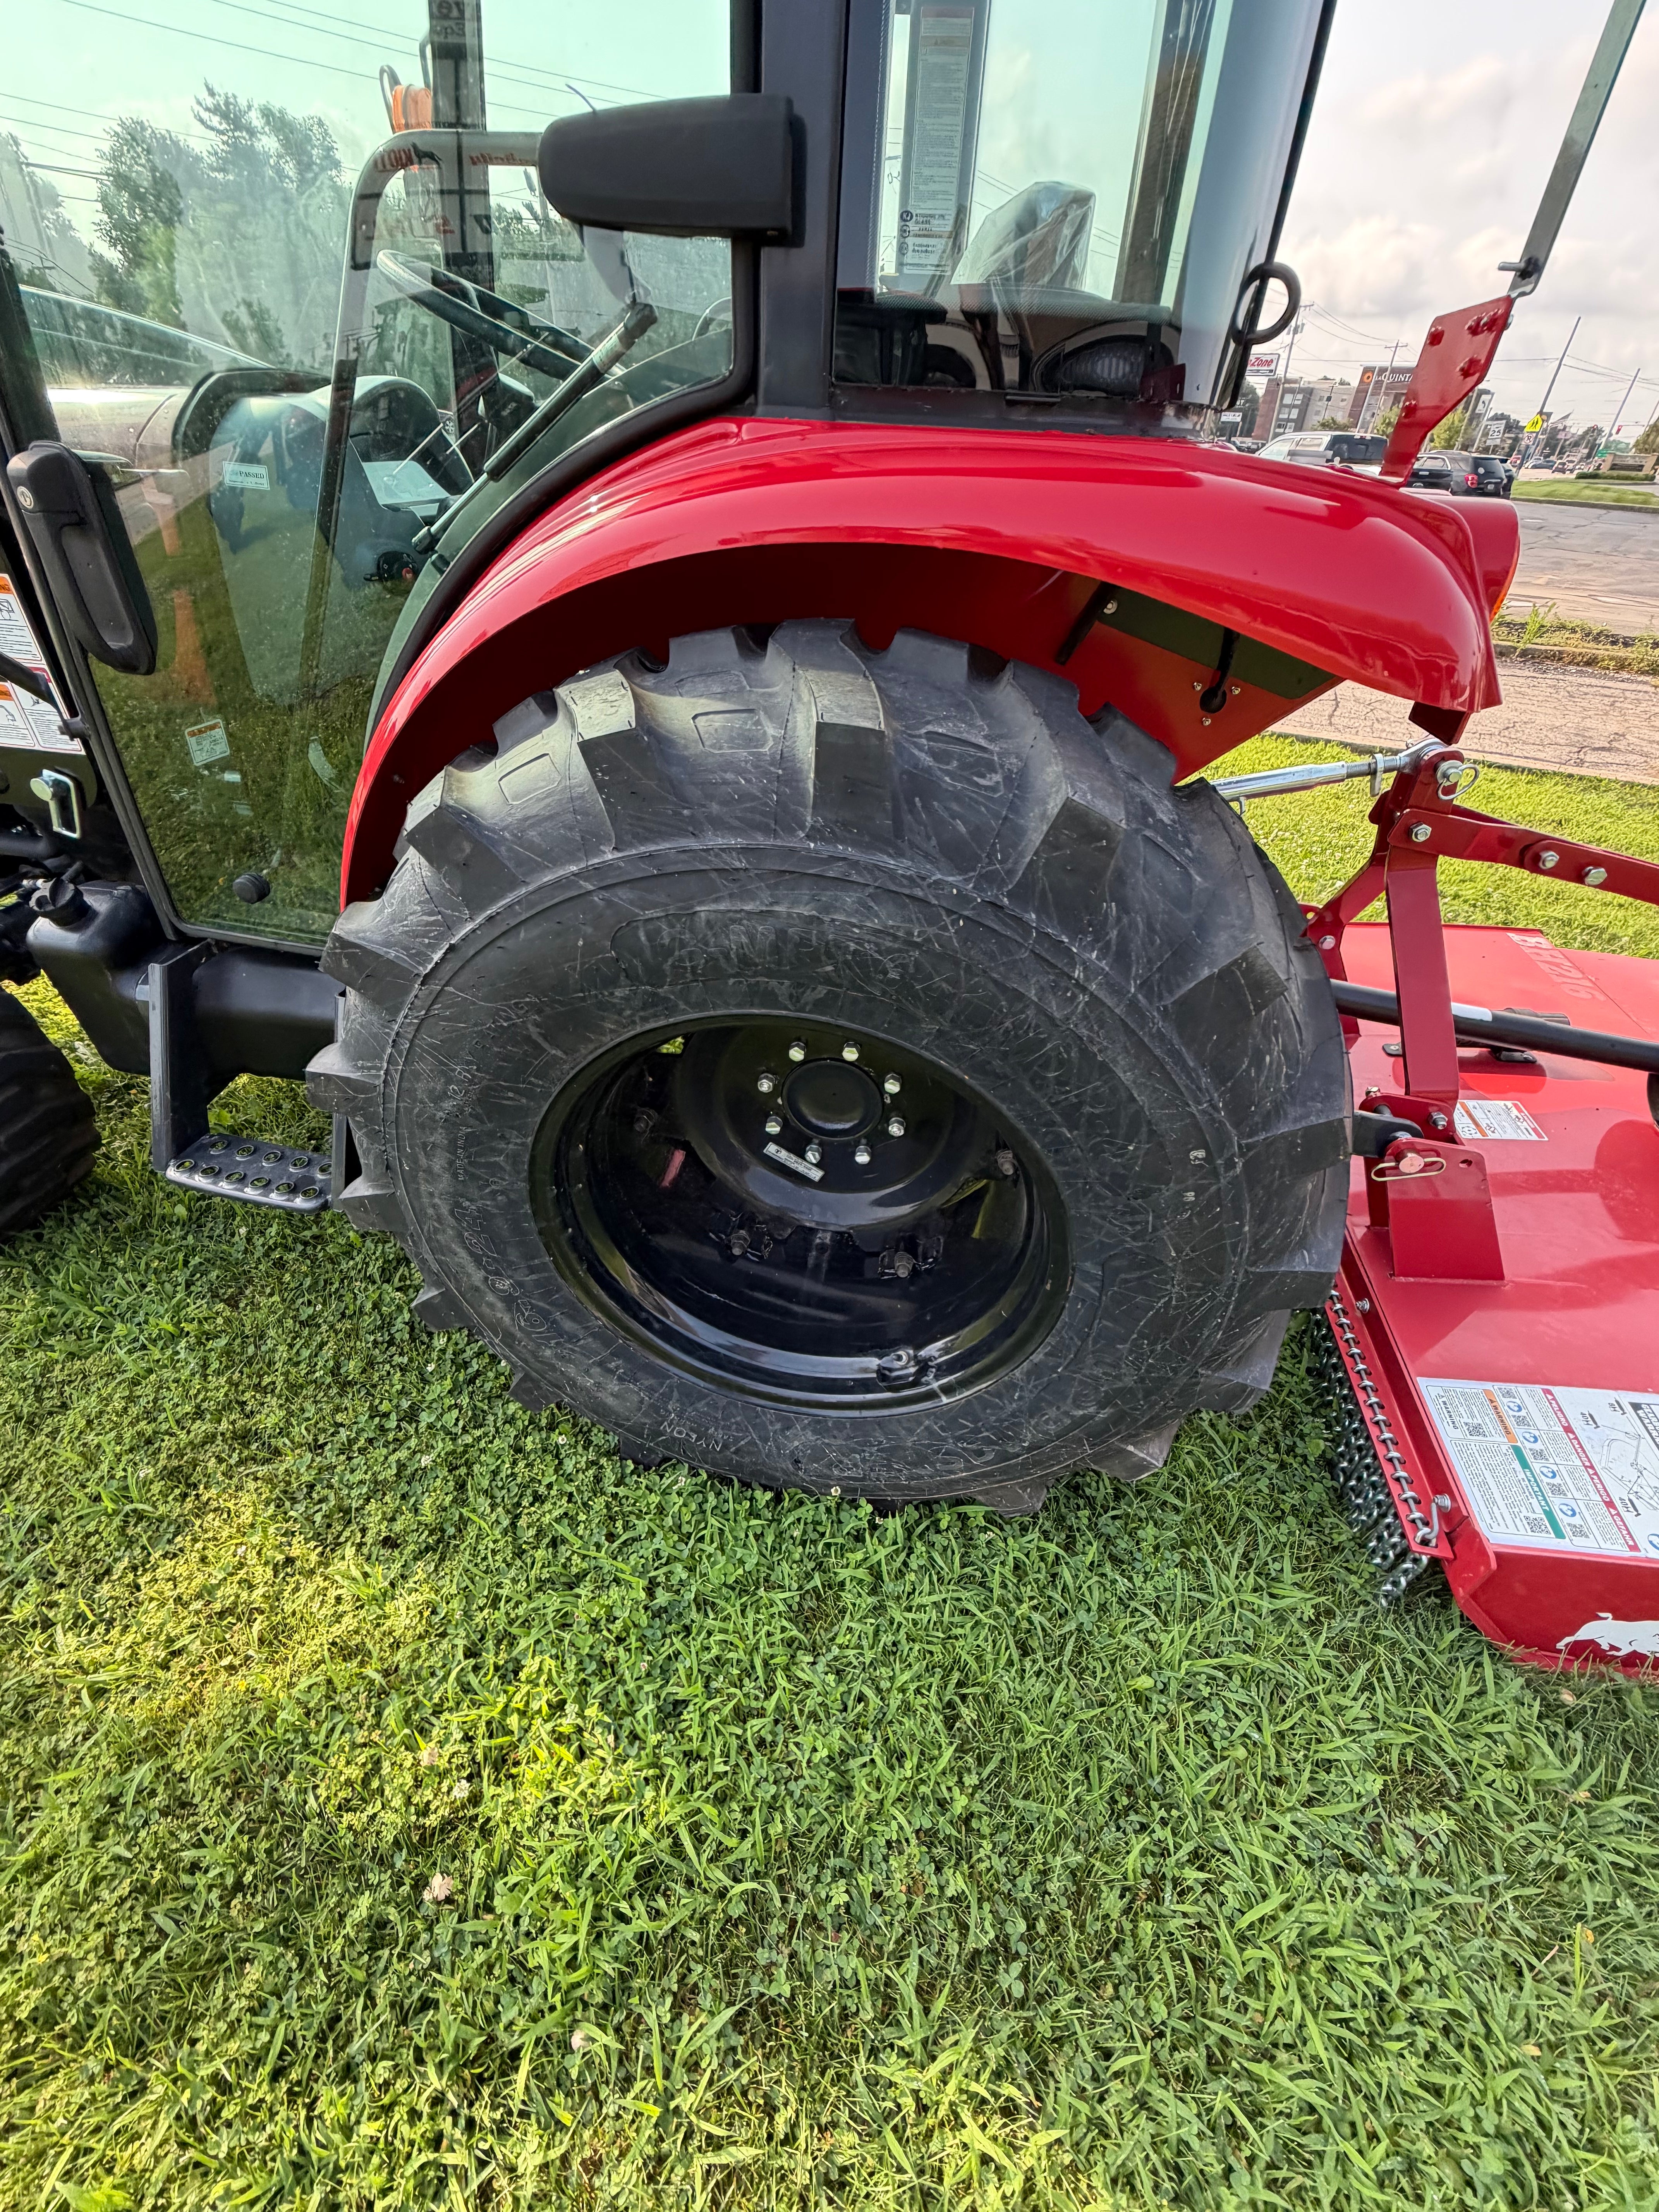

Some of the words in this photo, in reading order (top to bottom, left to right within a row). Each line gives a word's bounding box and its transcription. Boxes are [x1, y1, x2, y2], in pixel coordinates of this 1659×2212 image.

[1506, 933, 1607, 1001] BH216
[457, 1150, 464, 1158] IN
[457, 1158, 465, 1181] MADE
[1441, 1400, 1459, 1429] WARNING
[1491, 1405, 1511, 1435] WARNING
[1548, 1400, 1569, 1426] PELIGRO
[1570, 1439, 1591, 1466] DANGER
[1523, 1468, 1550, 1511] IMPORTANT
[1590, 1475, 1611, 1501] PERIGO
[1612, 1515, 1635, 1546] GEFAHR
